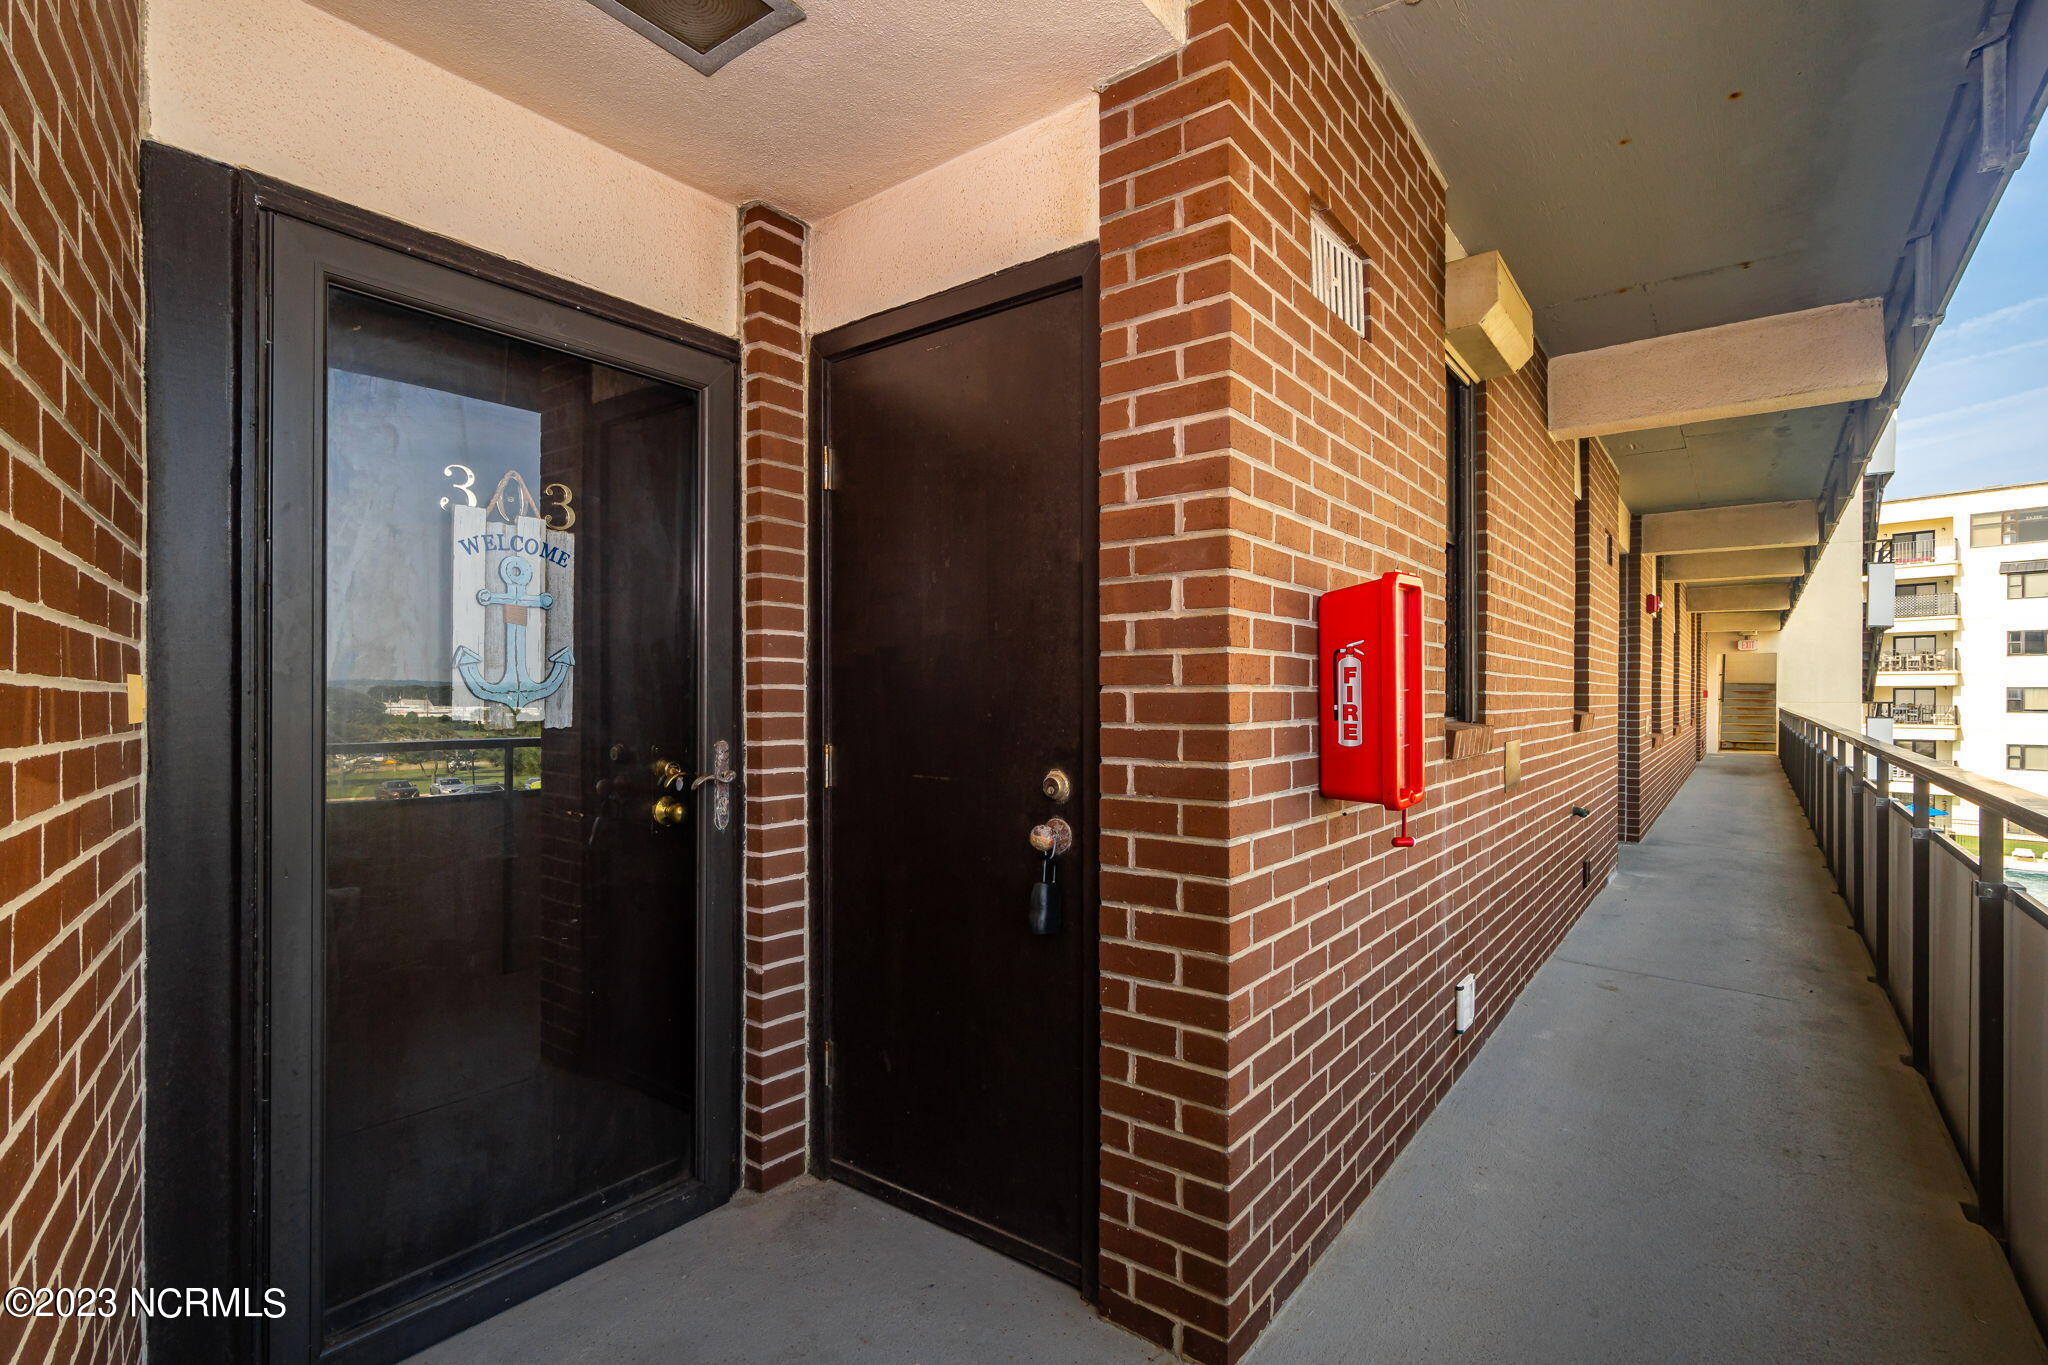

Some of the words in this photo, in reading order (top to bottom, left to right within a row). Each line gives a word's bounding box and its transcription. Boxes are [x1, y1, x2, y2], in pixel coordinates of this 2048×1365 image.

[458, 533, 571, 569] WELCOME
[1741, 640, 1755, 650] EXIT
[1343, 666, 1359, 742] FIRE
